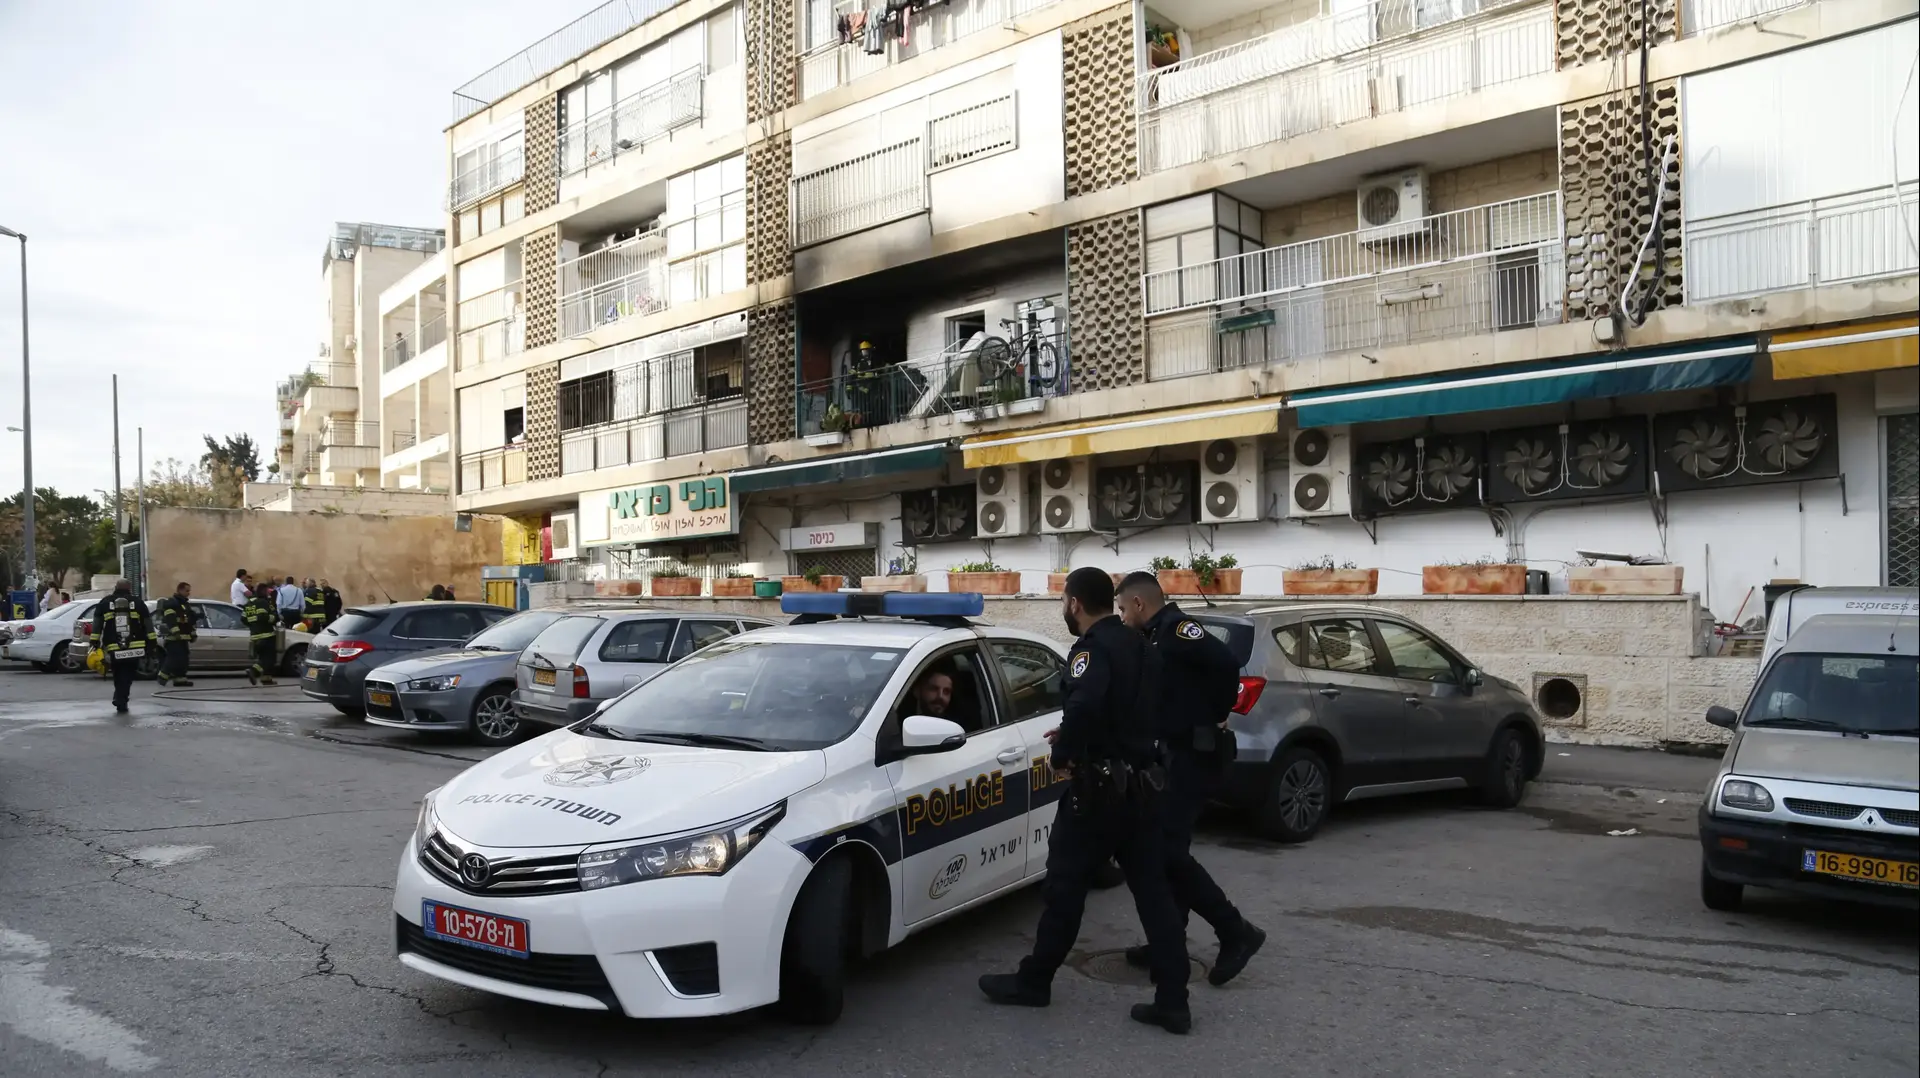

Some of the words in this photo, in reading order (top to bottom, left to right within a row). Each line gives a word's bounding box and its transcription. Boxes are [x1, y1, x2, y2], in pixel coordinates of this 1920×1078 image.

[609, 485, 671, 519] כדאי
[679, 477, 726, 512] הכי
[651, 517, 670, 531] מוזל
[675, 517, 694, 535] מזון
[699, 513, 726, 527] מרכז
[809, 531, 835, 545] כניסה
[1845, 601, 1909, 611] express
[458, 794, 535, 805] POLICE
[532, 796, 622, 826] משטרה
[906, 769, 1004, 835] POLICE
[980, 836, 1022, 866] ישראל
[946, 858, 963, 876] 100
